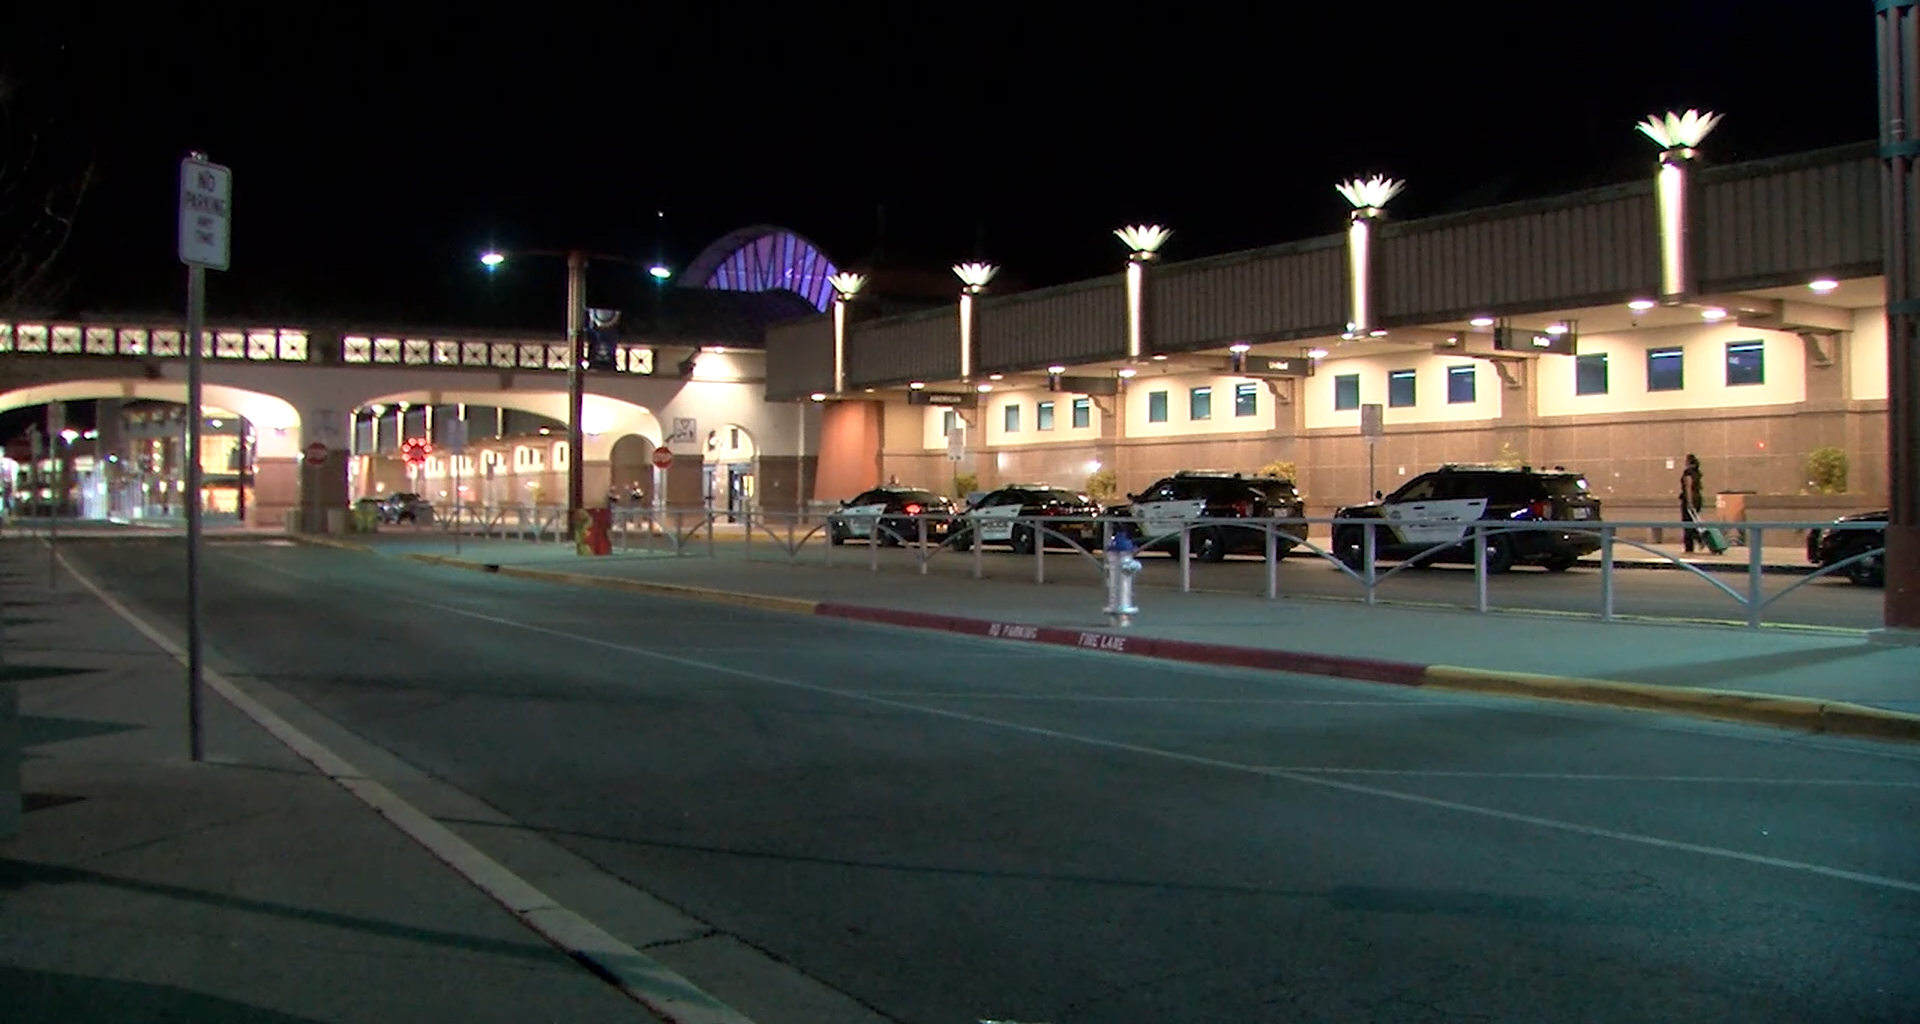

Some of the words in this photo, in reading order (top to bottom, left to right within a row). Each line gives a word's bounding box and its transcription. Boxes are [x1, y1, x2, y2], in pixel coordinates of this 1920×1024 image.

[198, 169, 215, 193] NO
[185, 190, 226, 217] PARKING
[988, 623, 1000, 636] NO
[1002, 624, 1039, 639] PARKING
[1078, 632, 1100, 648] FIRE
[1101, 635, 1128, 651] LANE
